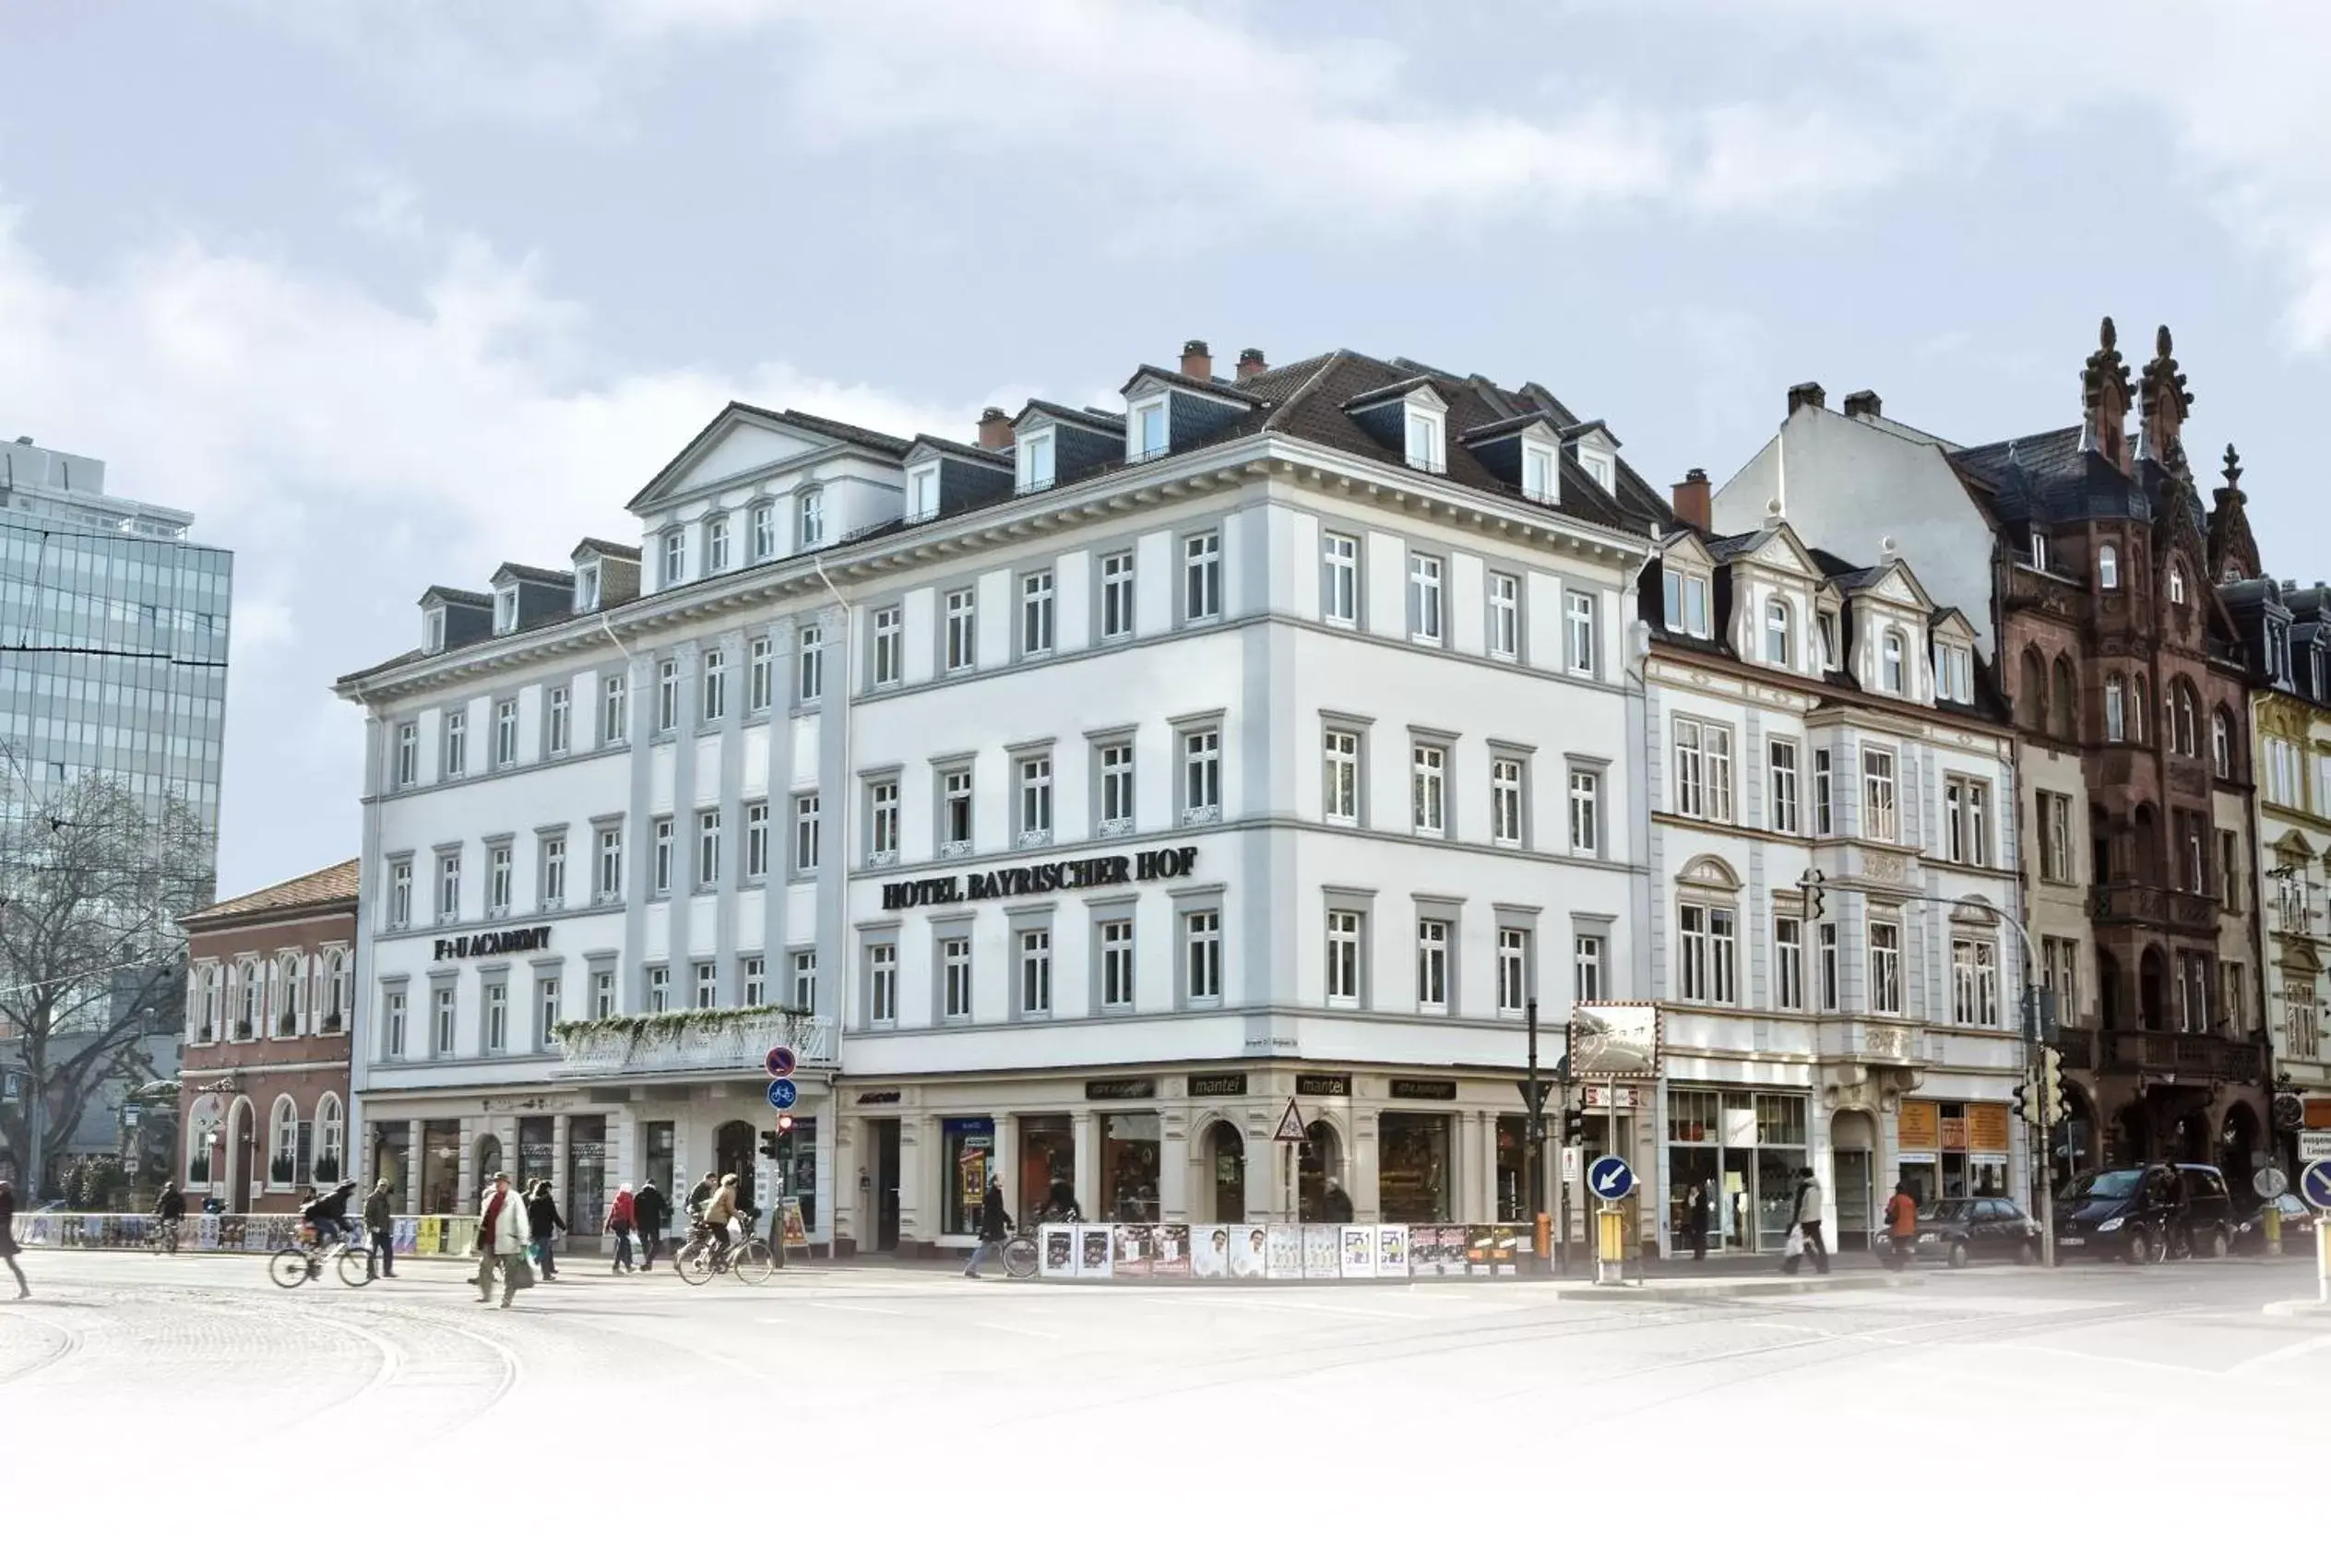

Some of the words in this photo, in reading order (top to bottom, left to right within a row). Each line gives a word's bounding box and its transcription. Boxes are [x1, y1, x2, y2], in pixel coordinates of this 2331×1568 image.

[882, 876, 963, 909] HOTEL
[967, 855, 1130, 901] BAYRISCHER
[1135, 846, 1197, 881] HOF
[470, 926, 552, 957] ACADEMY
